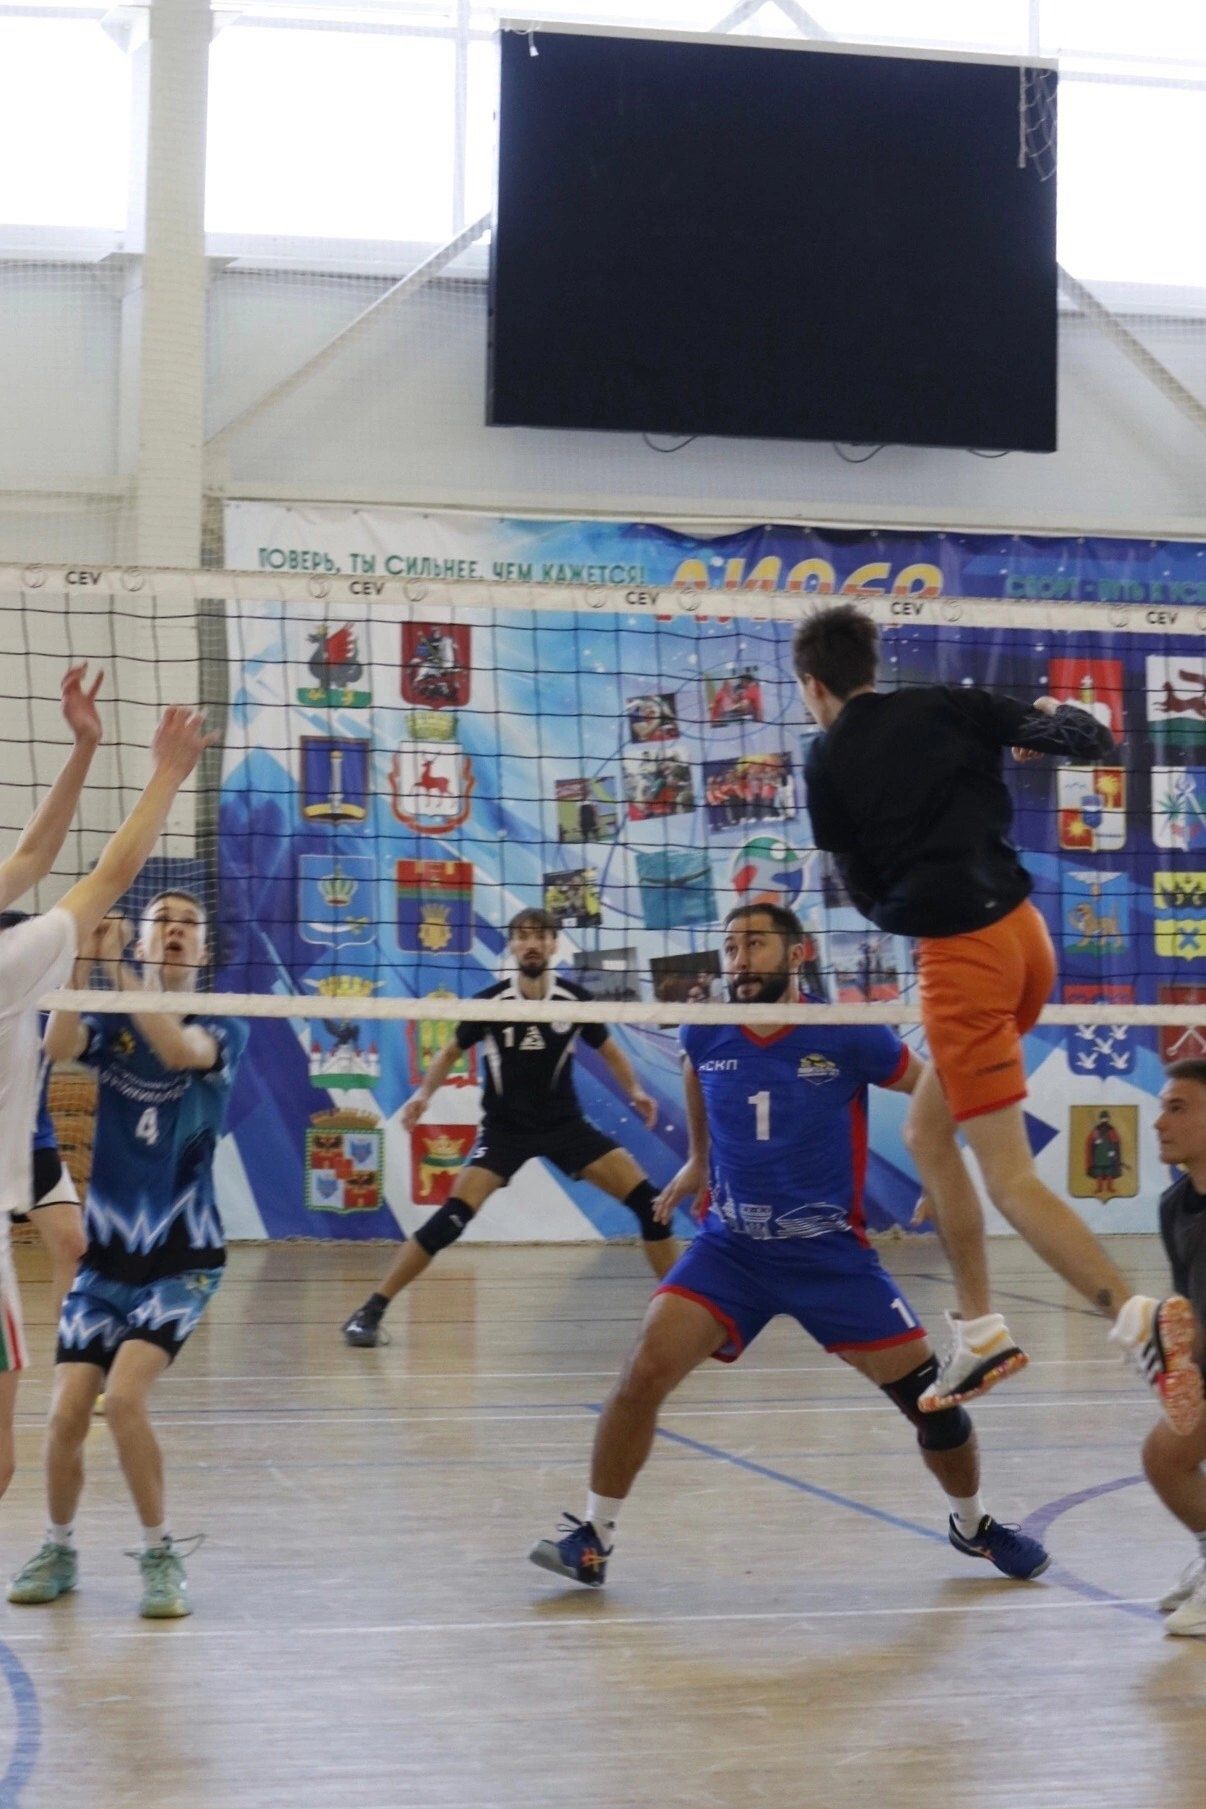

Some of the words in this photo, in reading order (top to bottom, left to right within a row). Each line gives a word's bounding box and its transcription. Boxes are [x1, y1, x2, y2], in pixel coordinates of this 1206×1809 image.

[349, 553, 376, 573] ТЫ
[492, 561, 532, 582] ЧЕМ
[542, 563, 646, 585] КАЖЕТСЯ!
[66, 571, 102, 585] CEV
[350, 581, 385, 596] CEV
[626, 591, 660, 606] CEV
[890, 601, 926, 616] CEV
[1146, 611, 1178, 625] CEV
[748, 1090, 770, 1141] 1
[135, 1107, 160, 1145] 4
[890, 1297, 914, 1328] 1
